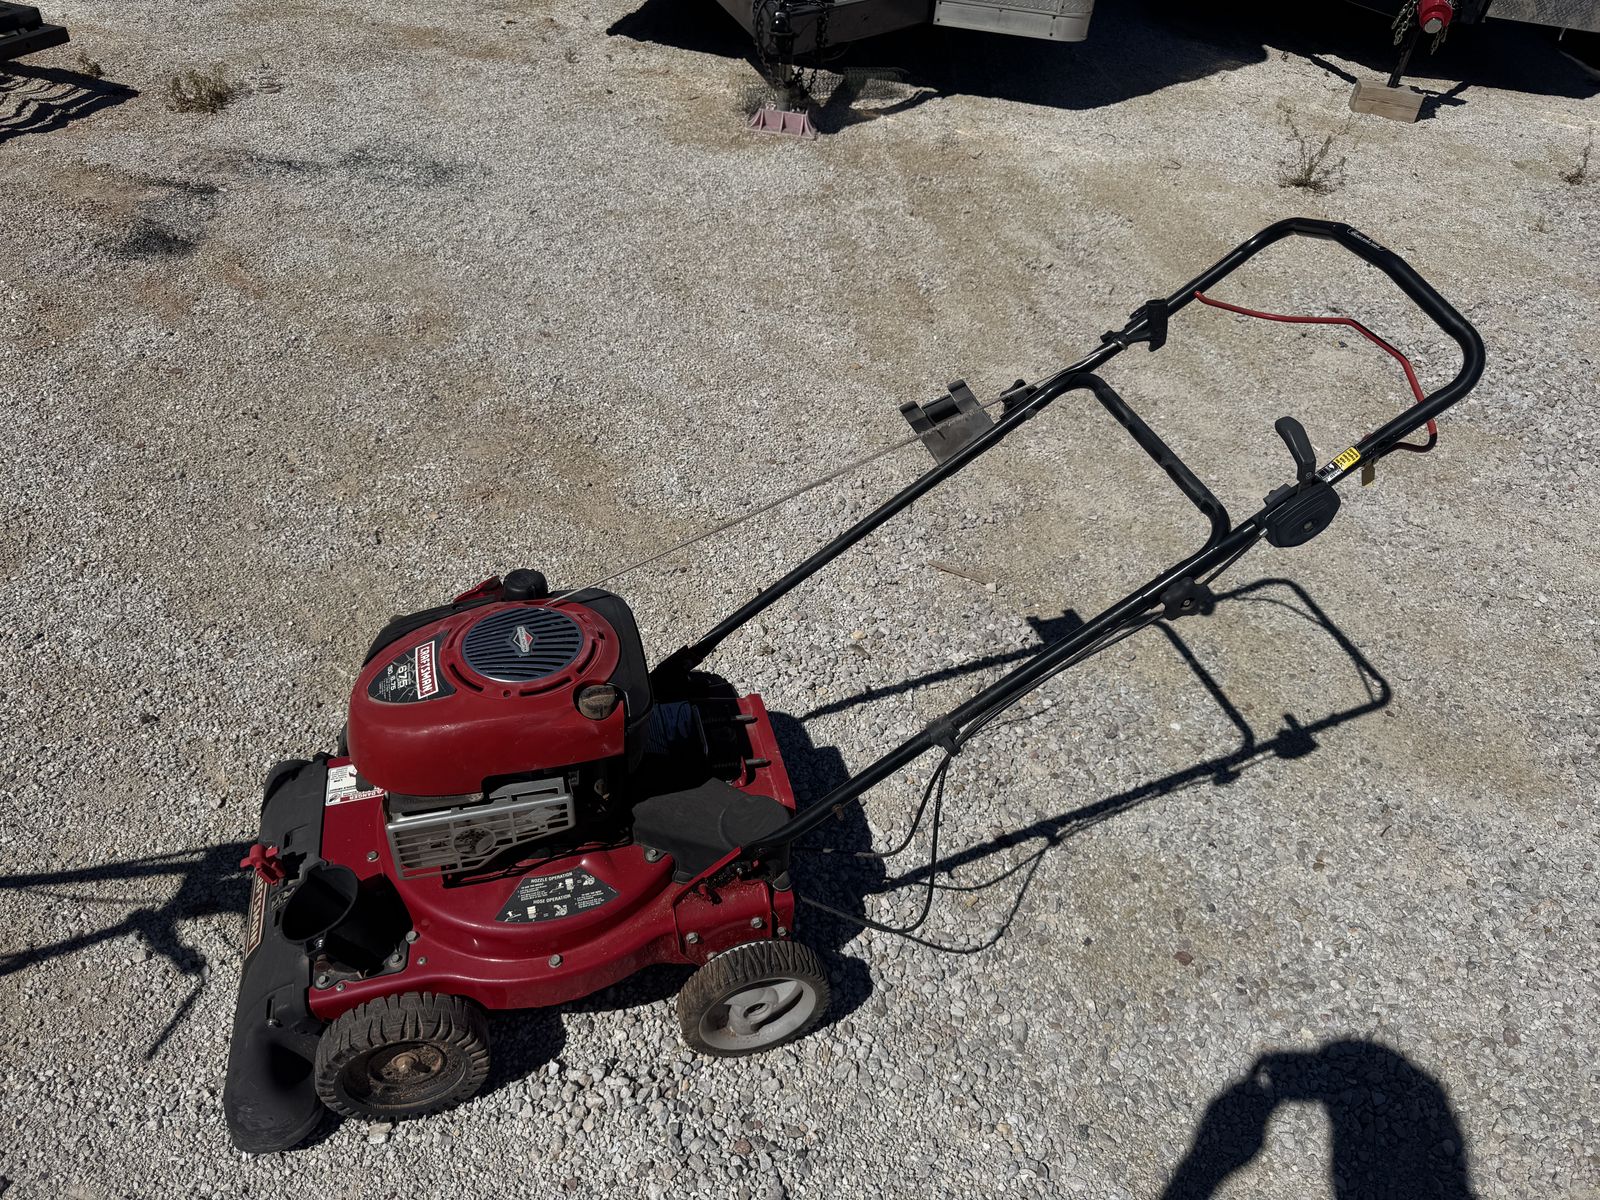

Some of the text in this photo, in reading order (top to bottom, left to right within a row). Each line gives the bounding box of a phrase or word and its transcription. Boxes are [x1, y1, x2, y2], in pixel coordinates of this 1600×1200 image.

[420, 646, 433, 693] CRAFTSMAN
[398, 665, 408, 688] 675
[350, 790, 376, 800] DANGER
[548, 872, 573, 881] OPERATION
[546, 894, 571, 903] OPERATION
